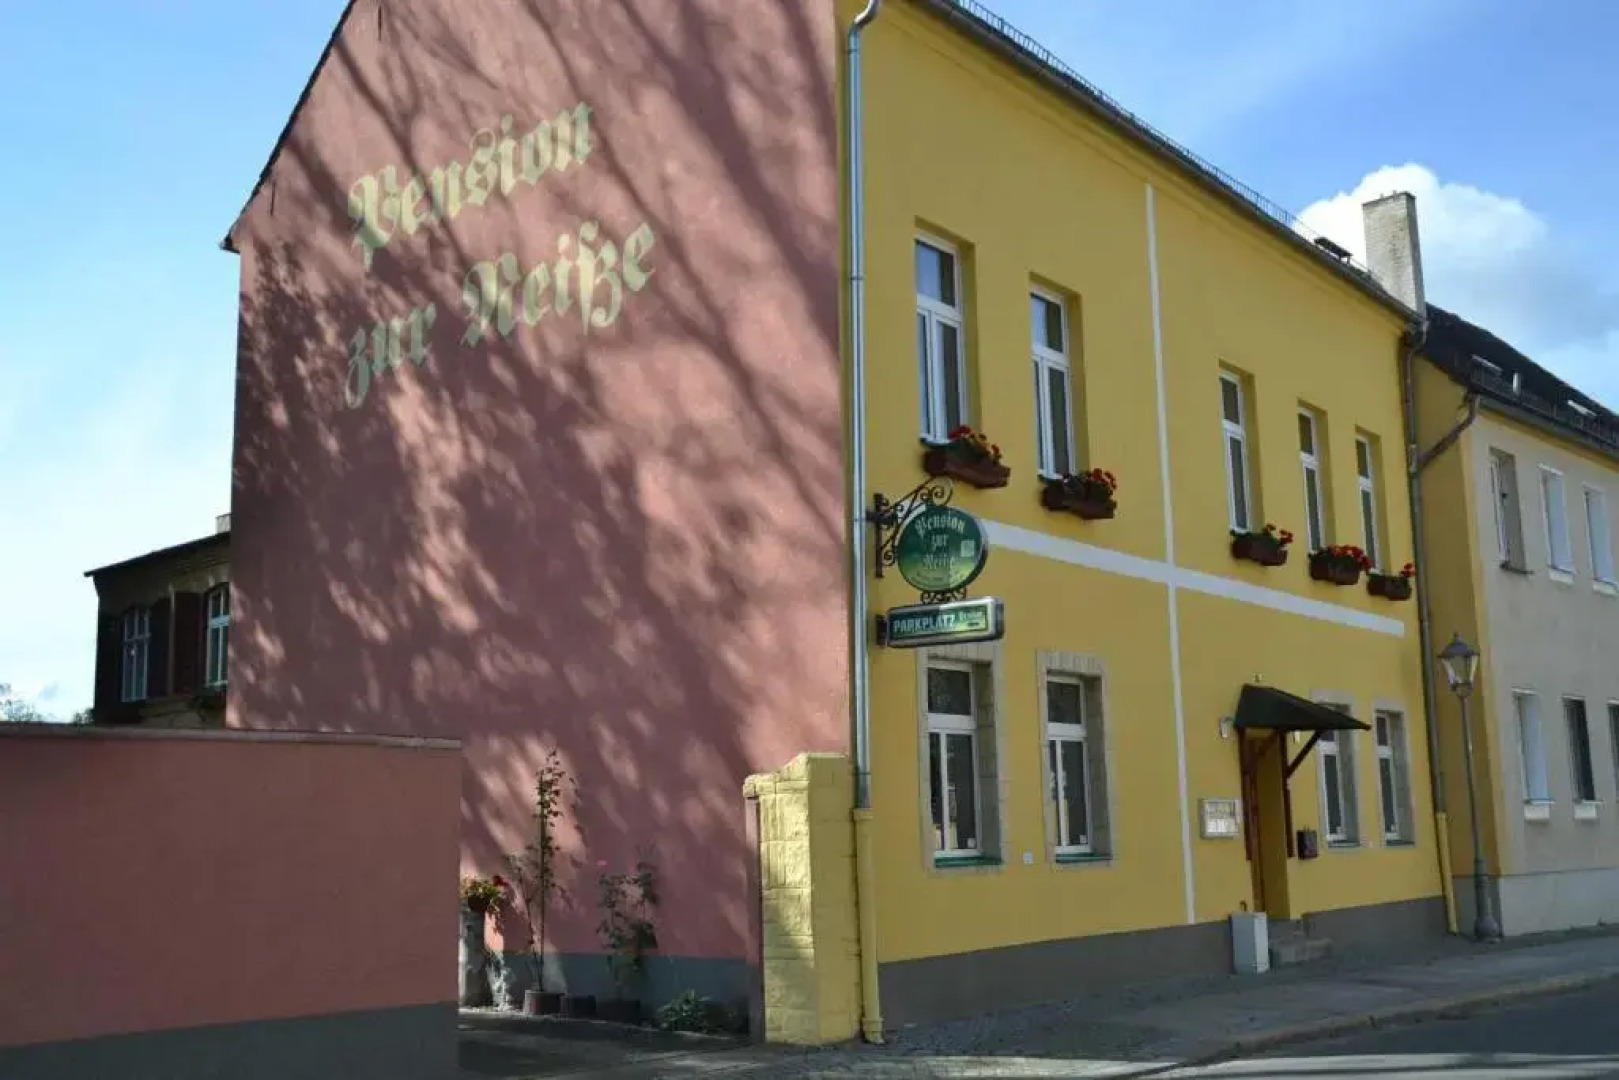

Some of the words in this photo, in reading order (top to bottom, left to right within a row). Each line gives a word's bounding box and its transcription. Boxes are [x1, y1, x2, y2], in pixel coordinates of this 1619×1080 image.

[348, 101, 594, 272] Pension
[345, 302, 436, 408] zur
[915, 513, 966, 539] Pension
[893, 615, 955, 633] PARKPLATZ
